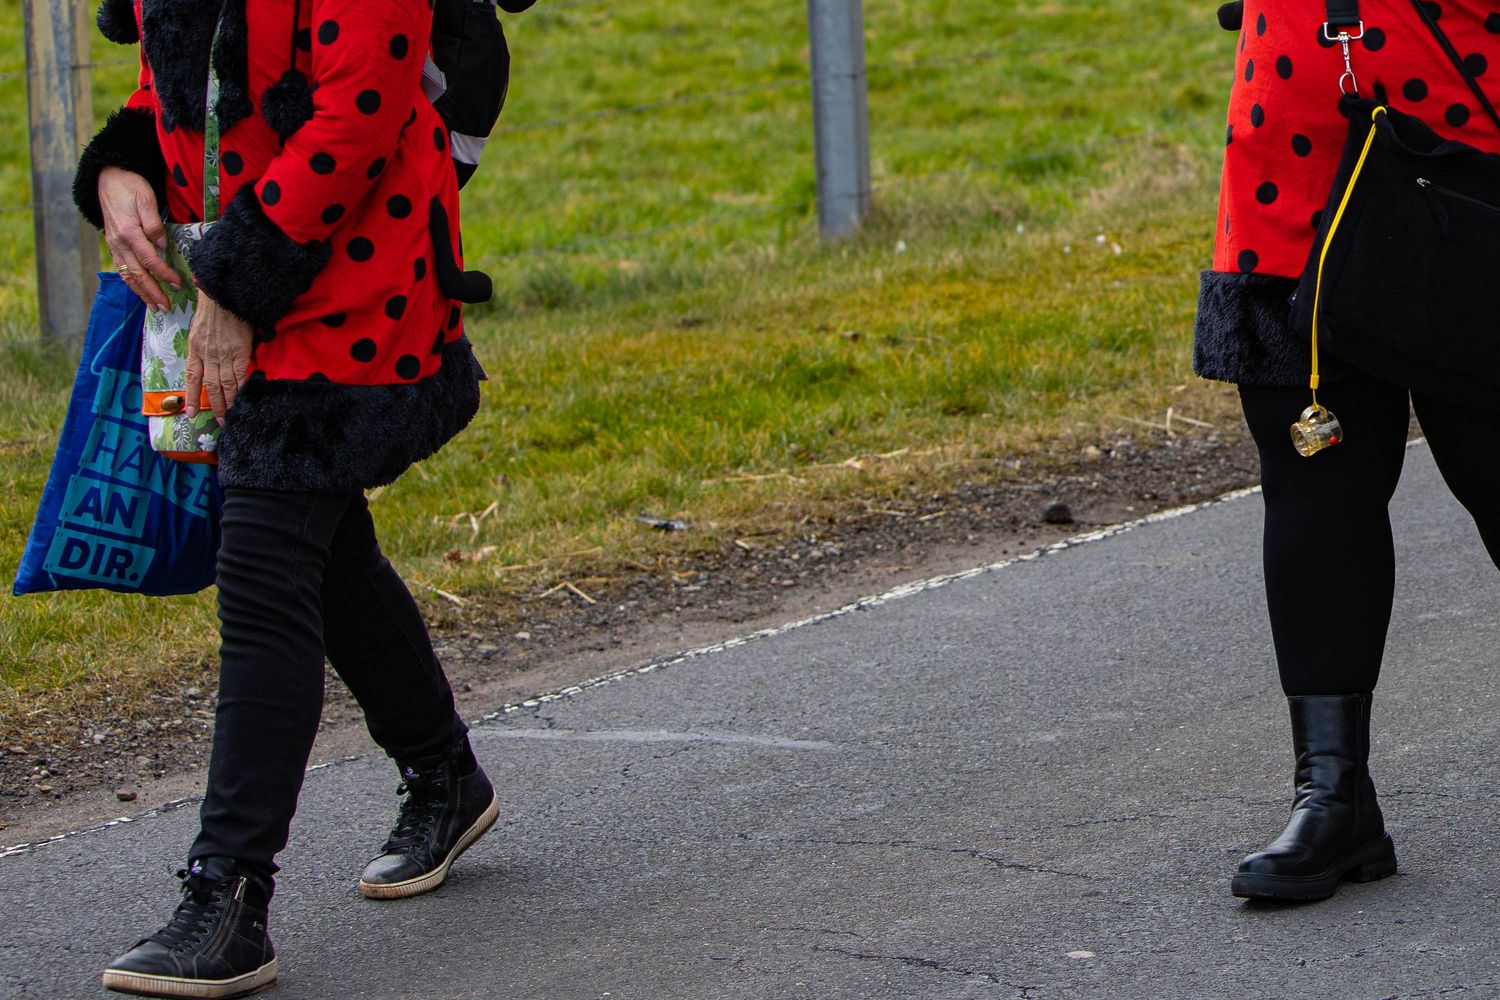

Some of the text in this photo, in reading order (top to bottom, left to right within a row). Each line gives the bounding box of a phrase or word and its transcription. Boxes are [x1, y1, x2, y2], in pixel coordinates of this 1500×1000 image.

[108, 375, 142, 415] IC
[72, 486, 139, 529] AN
[58, 537, 140, 583] DIR.
